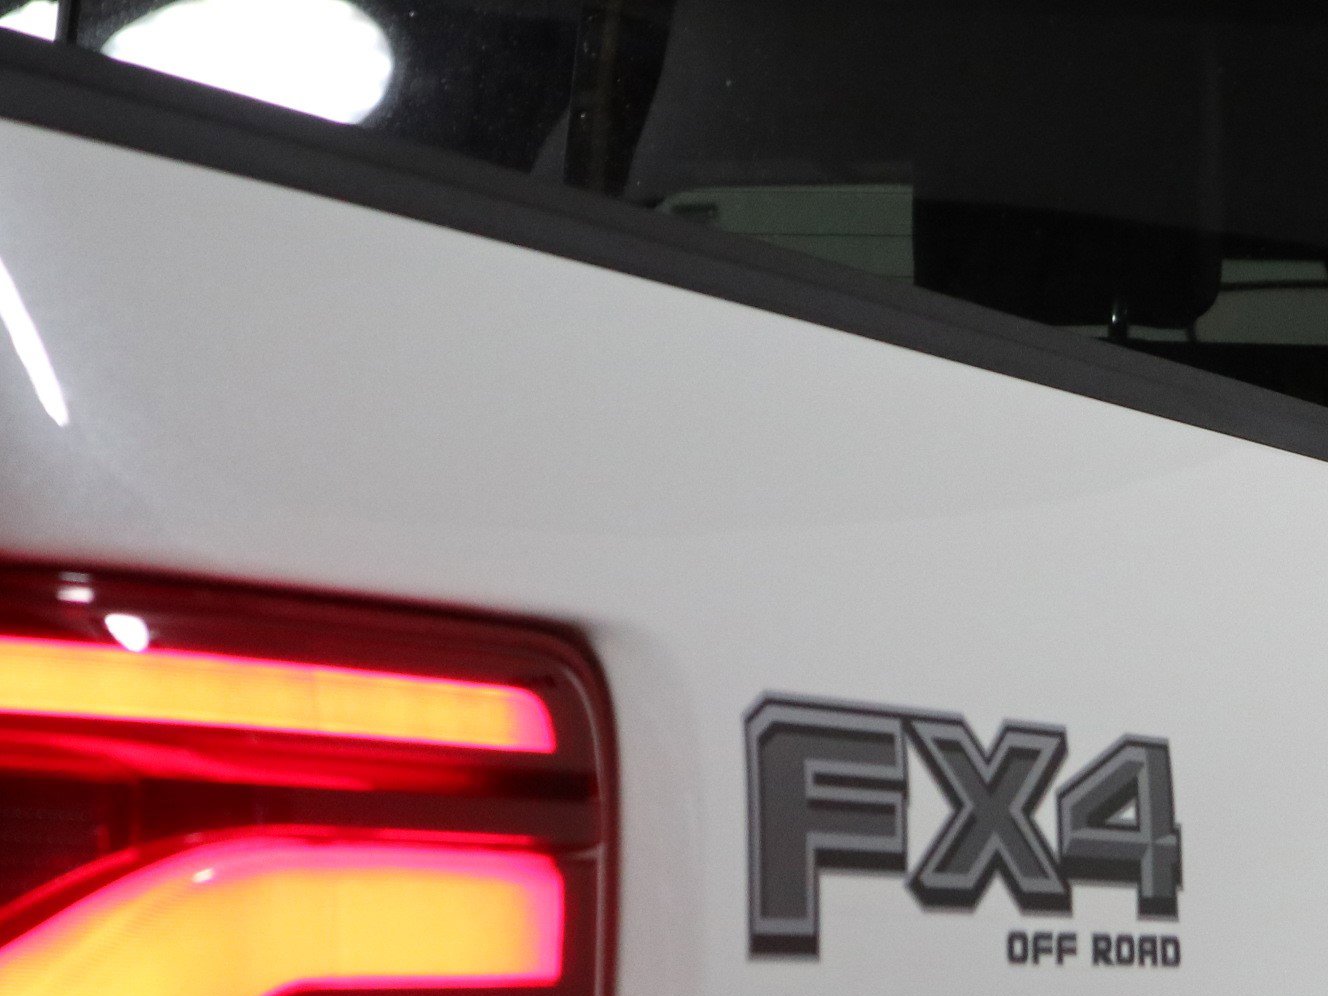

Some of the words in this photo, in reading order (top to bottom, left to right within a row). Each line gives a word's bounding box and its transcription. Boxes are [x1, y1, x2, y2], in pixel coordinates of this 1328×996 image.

[743, 690, 1184, 963] FX4
[1006, 930, 1078, 966] OFF
[1091, 932, 1182, 968] ROAD
